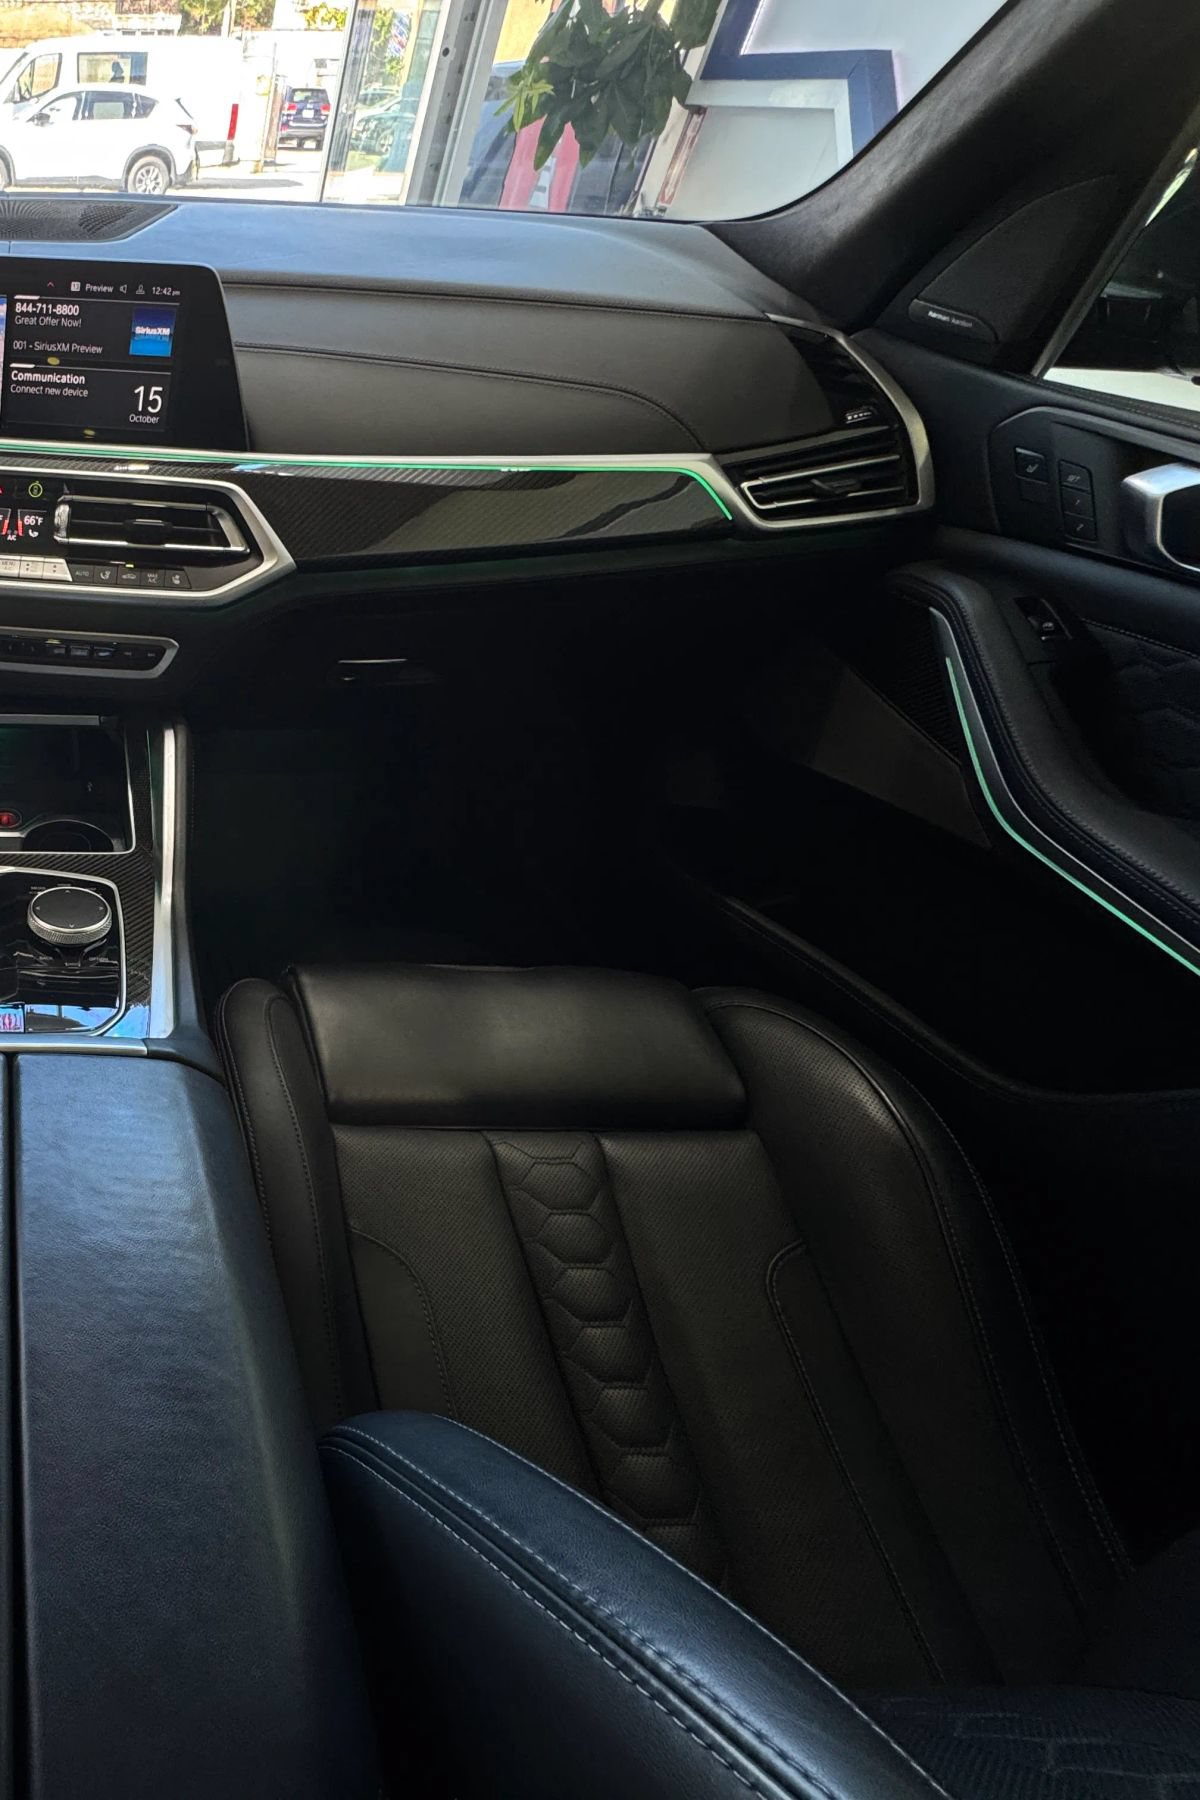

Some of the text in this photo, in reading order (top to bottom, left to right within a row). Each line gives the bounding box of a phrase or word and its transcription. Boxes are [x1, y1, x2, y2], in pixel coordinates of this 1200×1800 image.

[85, 283, 113, 293] Preview
[152, 286, 172, 296] 12:42
[14, 302, 80, 316] 844-711-8800
[14, 316, 83, 328] Great Offer Now!
[134, 325, 171, 336] SiriusXM
[13, 340, 27, 350] 001
[33, 341, 70, 352] SiriusXM
[71, 343, 103, 354] Preview
[11, 370, 86, 385] Communication
[10, 383, 89, 398] Connect new device
[133, 385, 164, 414] 15
[129, 413, 160, 424] October
[23, 515, 44, 527] 66°F
[75, 569, 90, 577] AUTO
